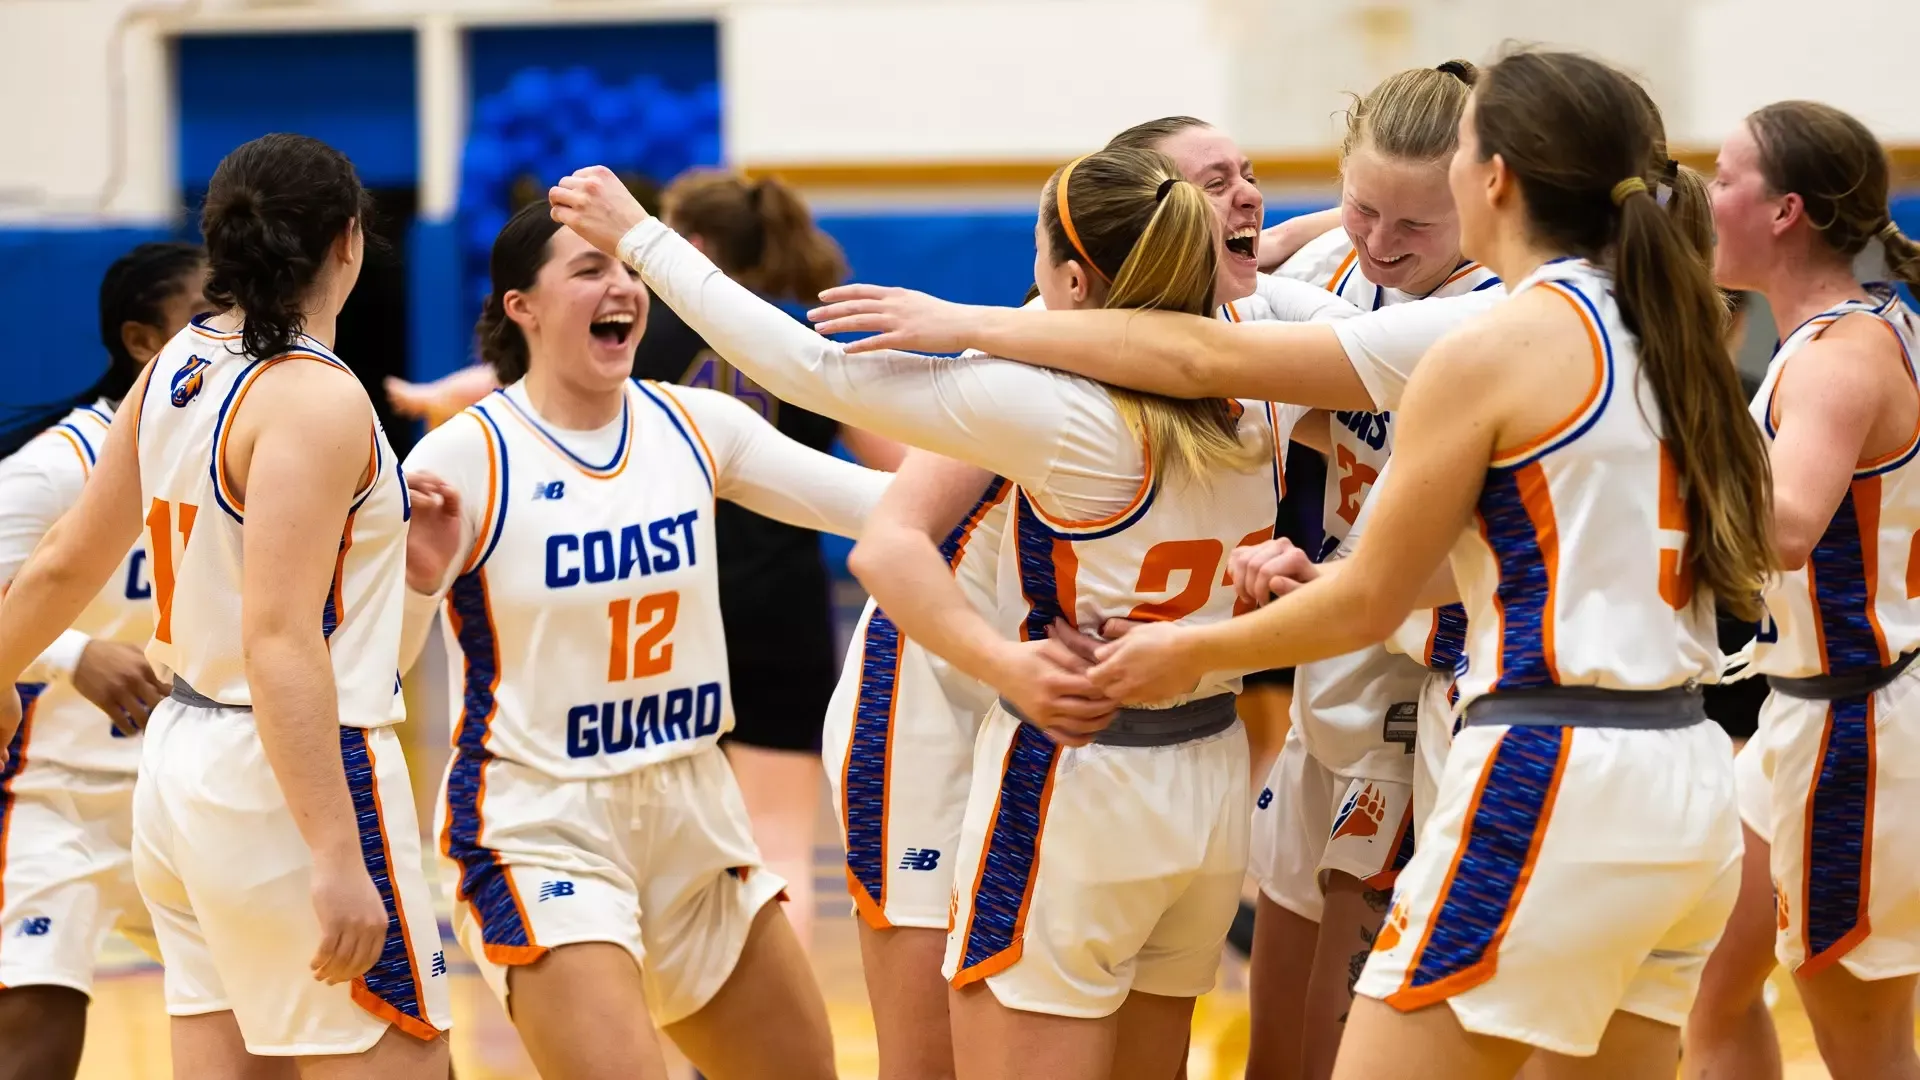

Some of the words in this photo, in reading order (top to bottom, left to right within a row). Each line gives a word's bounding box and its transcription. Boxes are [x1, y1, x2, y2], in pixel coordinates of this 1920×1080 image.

[545, 509, 698, 588] COAST
[607, 589, 681, 683] 12
[566, 681, 722, 759] GUARD
[538, 880, 575, 902] NB
[898, 847, 941, 871] NB
